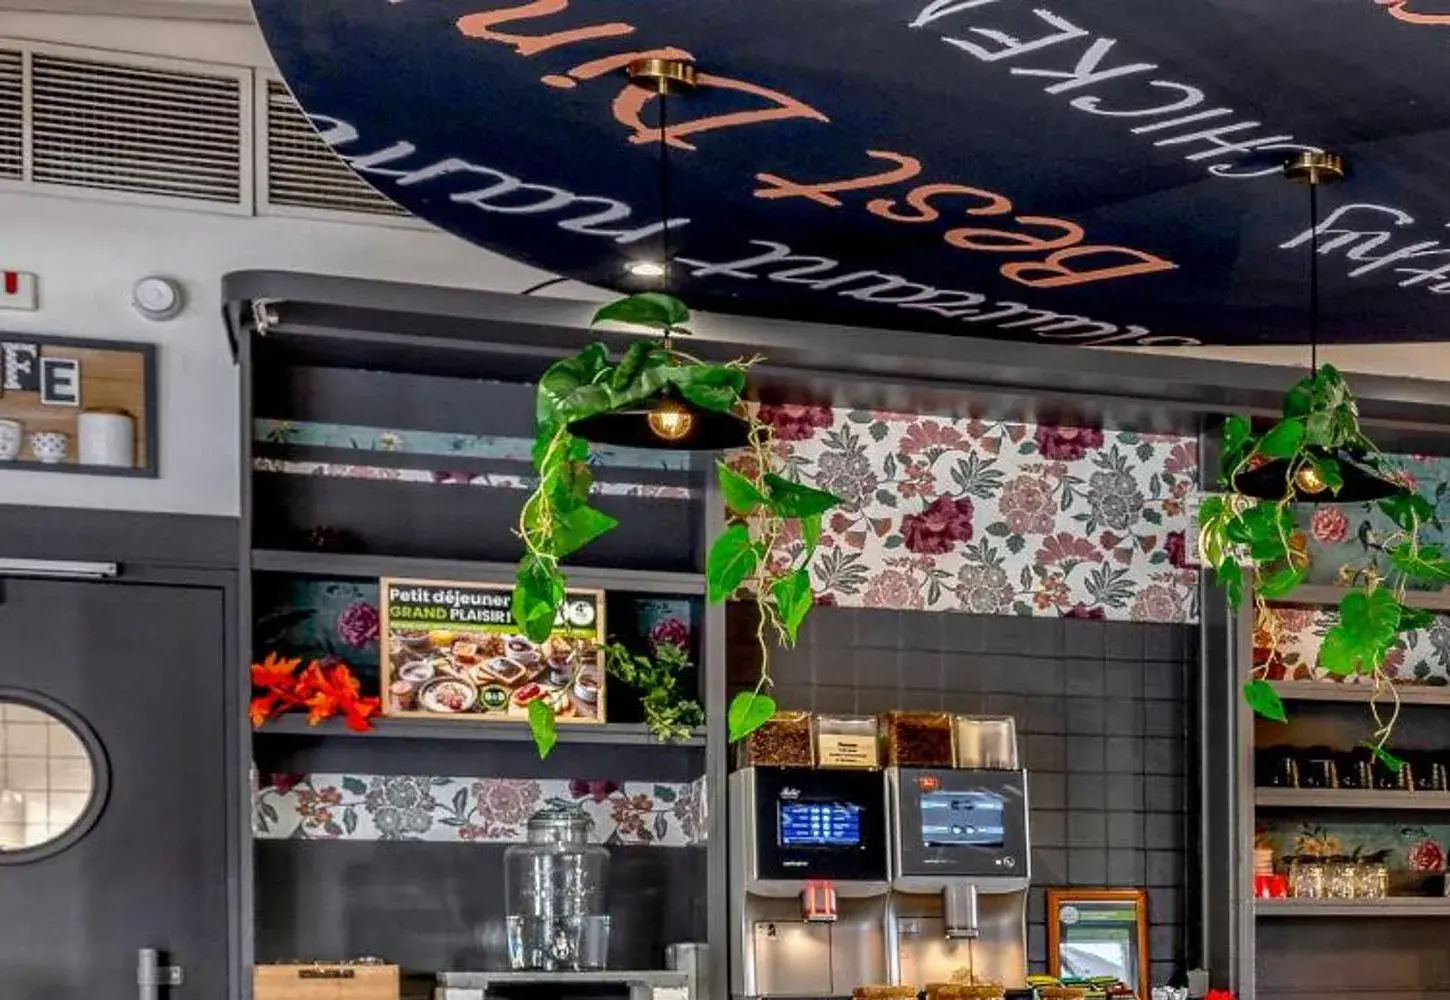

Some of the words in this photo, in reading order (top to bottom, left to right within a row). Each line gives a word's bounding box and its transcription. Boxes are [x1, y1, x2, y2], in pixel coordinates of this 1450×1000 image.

[454, 0, 830, 150] Din
[754, 150, 1177, 288] Best
[389, 587, 431, 603] Petit
[432, 588, 511, 608] déjeuner
[389, 605, 447, 620] GRAND
